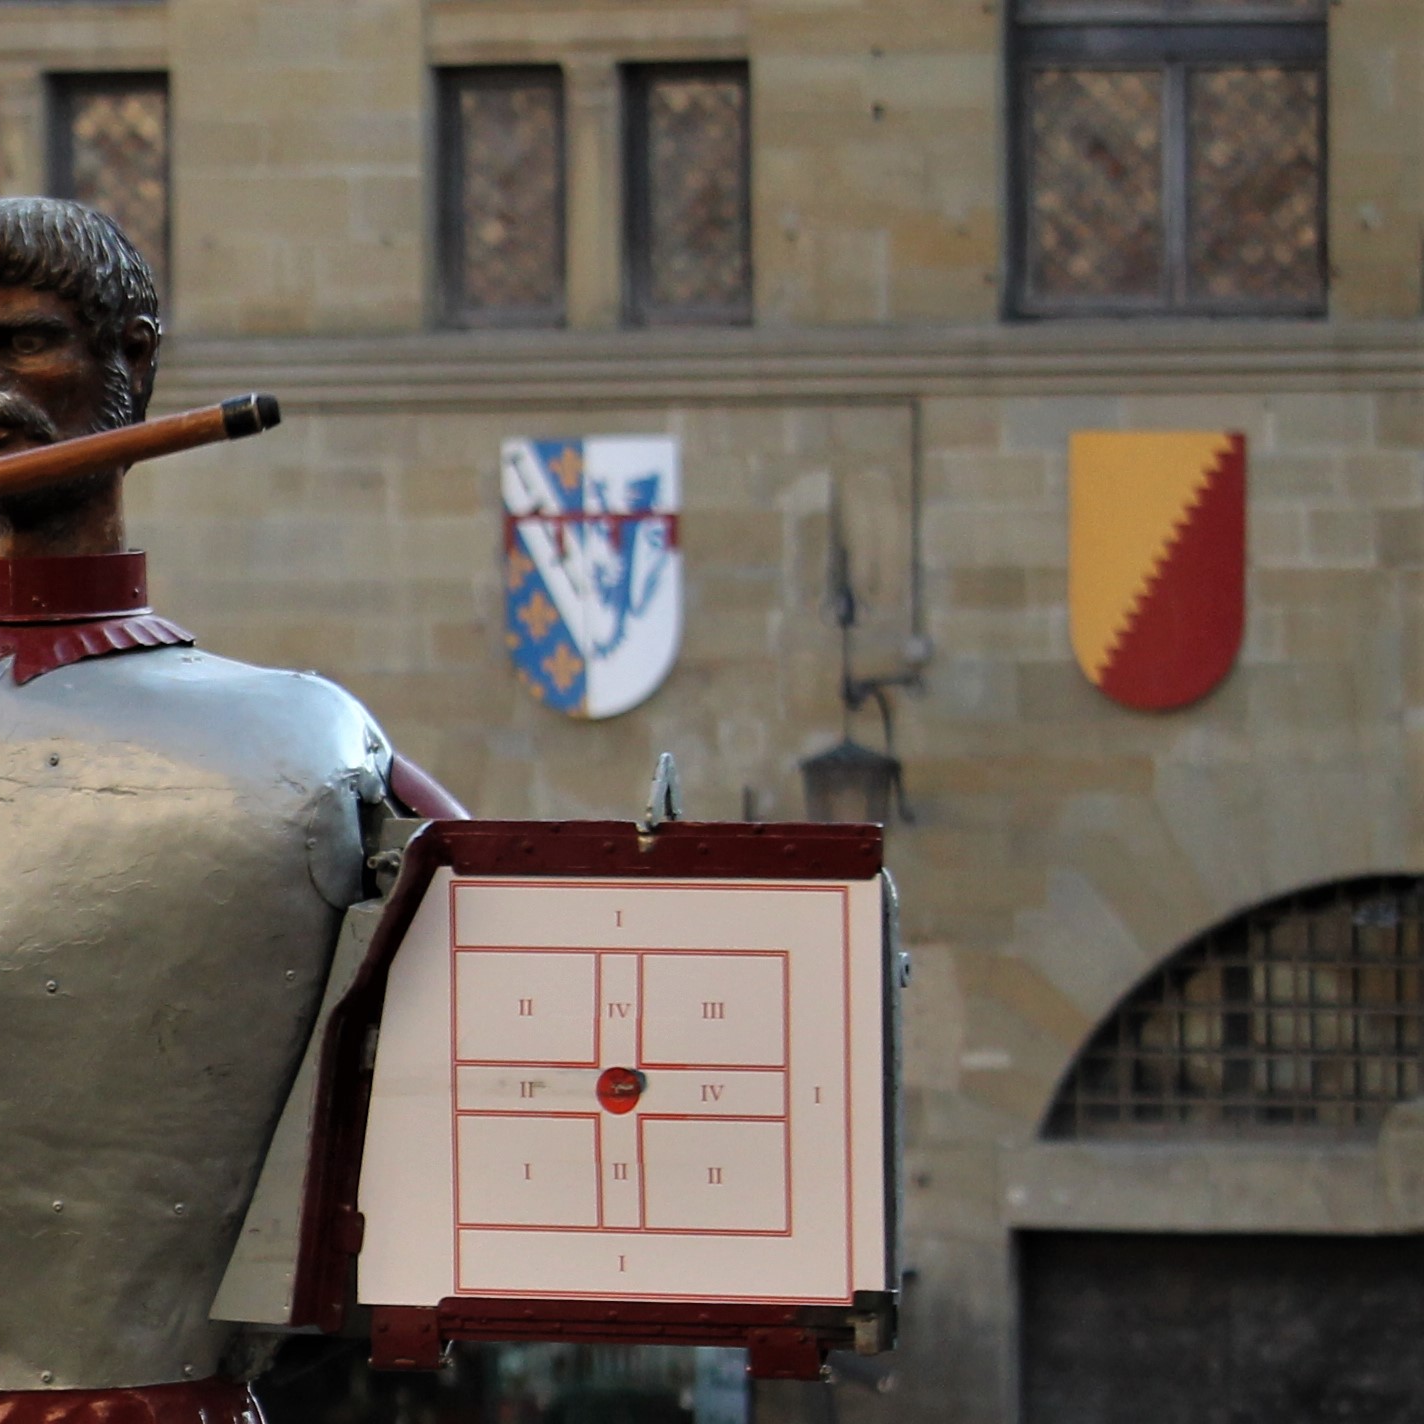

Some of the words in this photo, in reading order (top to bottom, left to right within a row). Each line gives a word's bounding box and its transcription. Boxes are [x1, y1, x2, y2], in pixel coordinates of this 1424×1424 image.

[518, 999, 533, 1016] II
[607, 1003, 633, 1019] IV
[701, 1001, 725, 1019] III
[518, 1081, 533, 1099] II
[701, 1085, 725, 1102] IV
[612, 1163, 628, 1180] II
[707, 1167, 722, 1184] II
